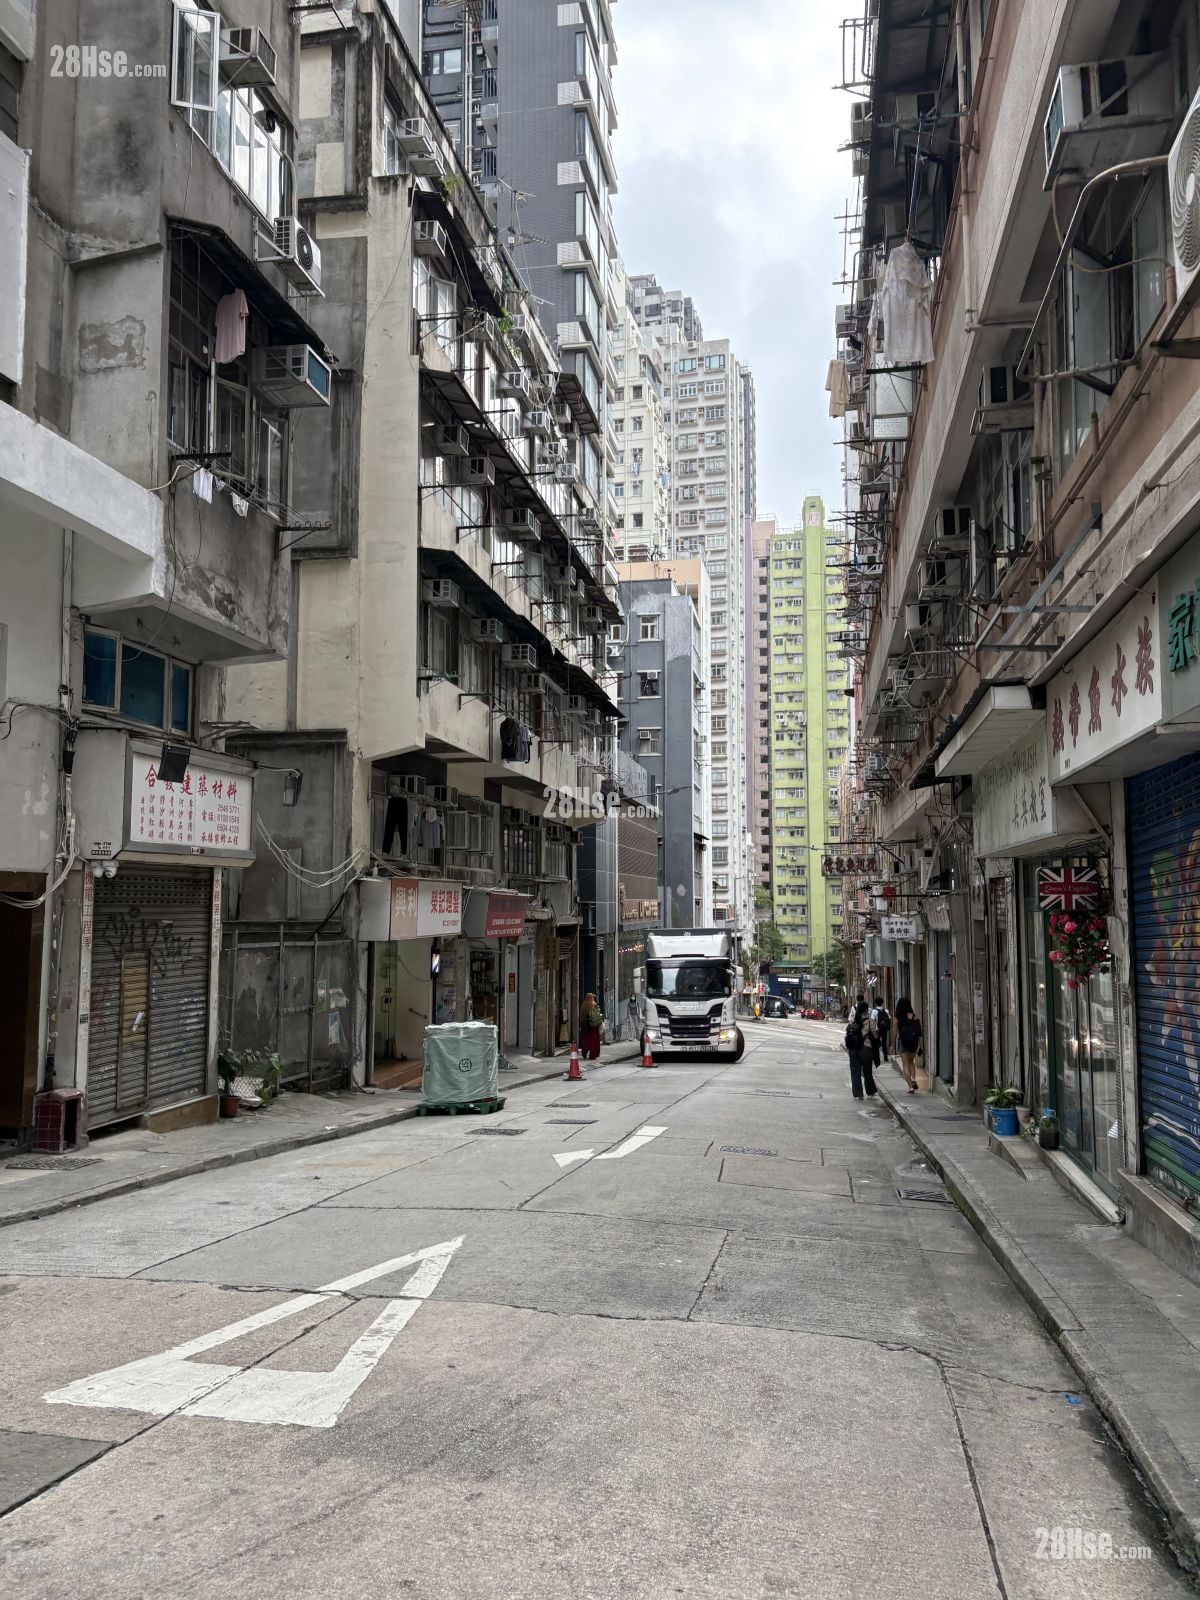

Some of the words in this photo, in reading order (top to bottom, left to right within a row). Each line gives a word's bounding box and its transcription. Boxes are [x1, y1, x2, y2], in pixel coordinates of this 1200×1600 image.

[395, 886, 418, 918] 興利
[431, 889, 459, 915] 榮記理髮
